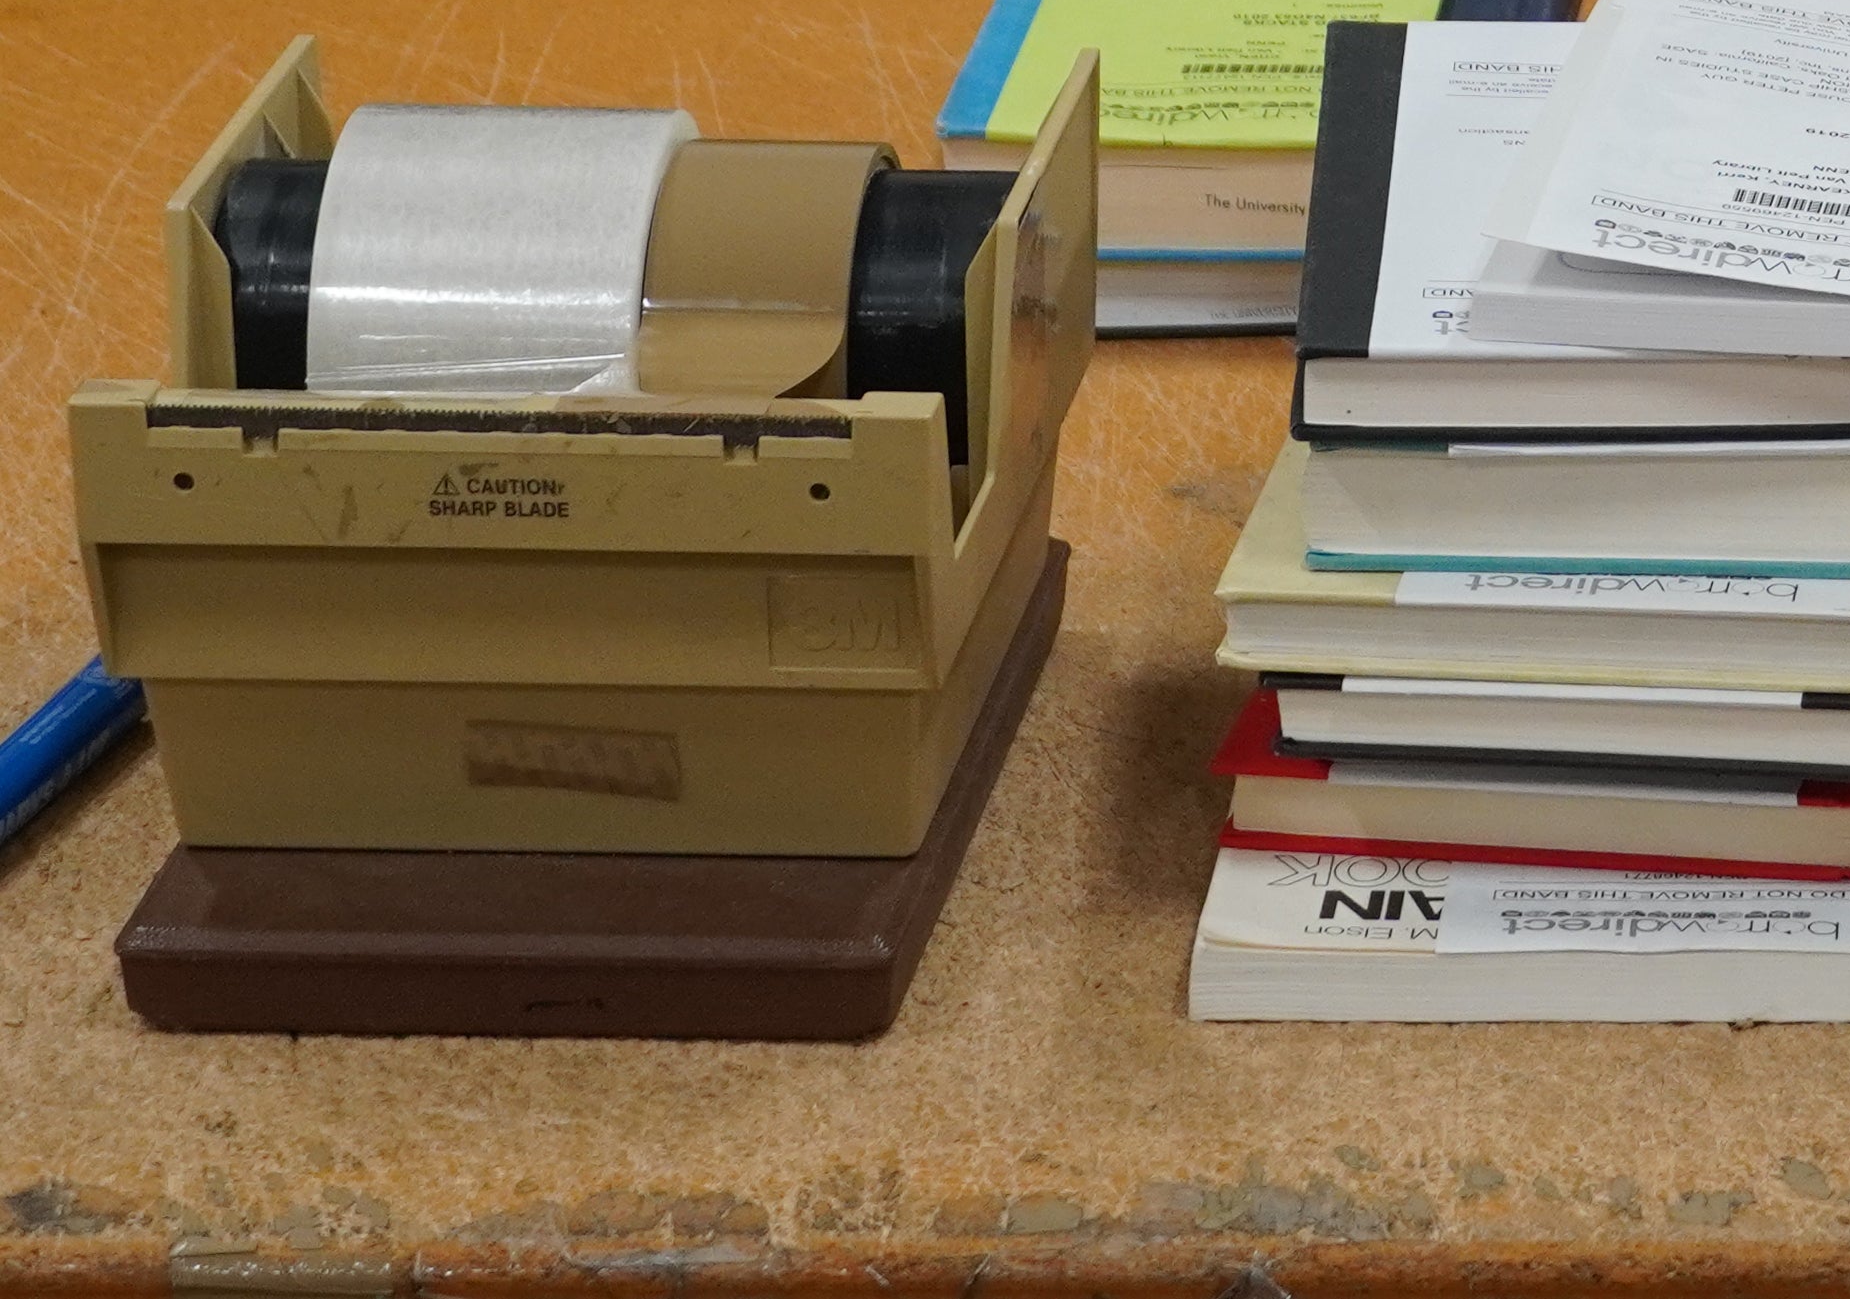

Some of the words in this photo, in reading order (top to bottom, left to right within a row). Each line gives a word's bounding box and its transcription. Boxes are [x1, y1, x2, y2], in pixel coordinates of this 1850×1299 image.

[1712, 160, 1772, 173] Library
[1205, 193, 1231, 209] The
[1236, 197, 1306, 216] University
[1600, 197, 1665, 218] BAND
[1674, 213, 1725, 227] THIS
[1735, 222, 1838, 242] REMOVE
[429, 500, 497, 518] SHARP
[504, 500, 570, 518] BLADE
[1466, 574, 1799, 604] borrowdirect
[1501, 889, 1567, 900] BAND
[1573, 889, 1622, 900] THIS
[1629, 889, 1743, 901] REMOVE
[1751, 889, 1795, 899] NOT
[1802, 889, 1846, 900] DO
[1319, 889, 1446, 921] AIN
[1304, 923, 1392, 940] Elson
[1502, 916, 1839, 941] borrowdirect
